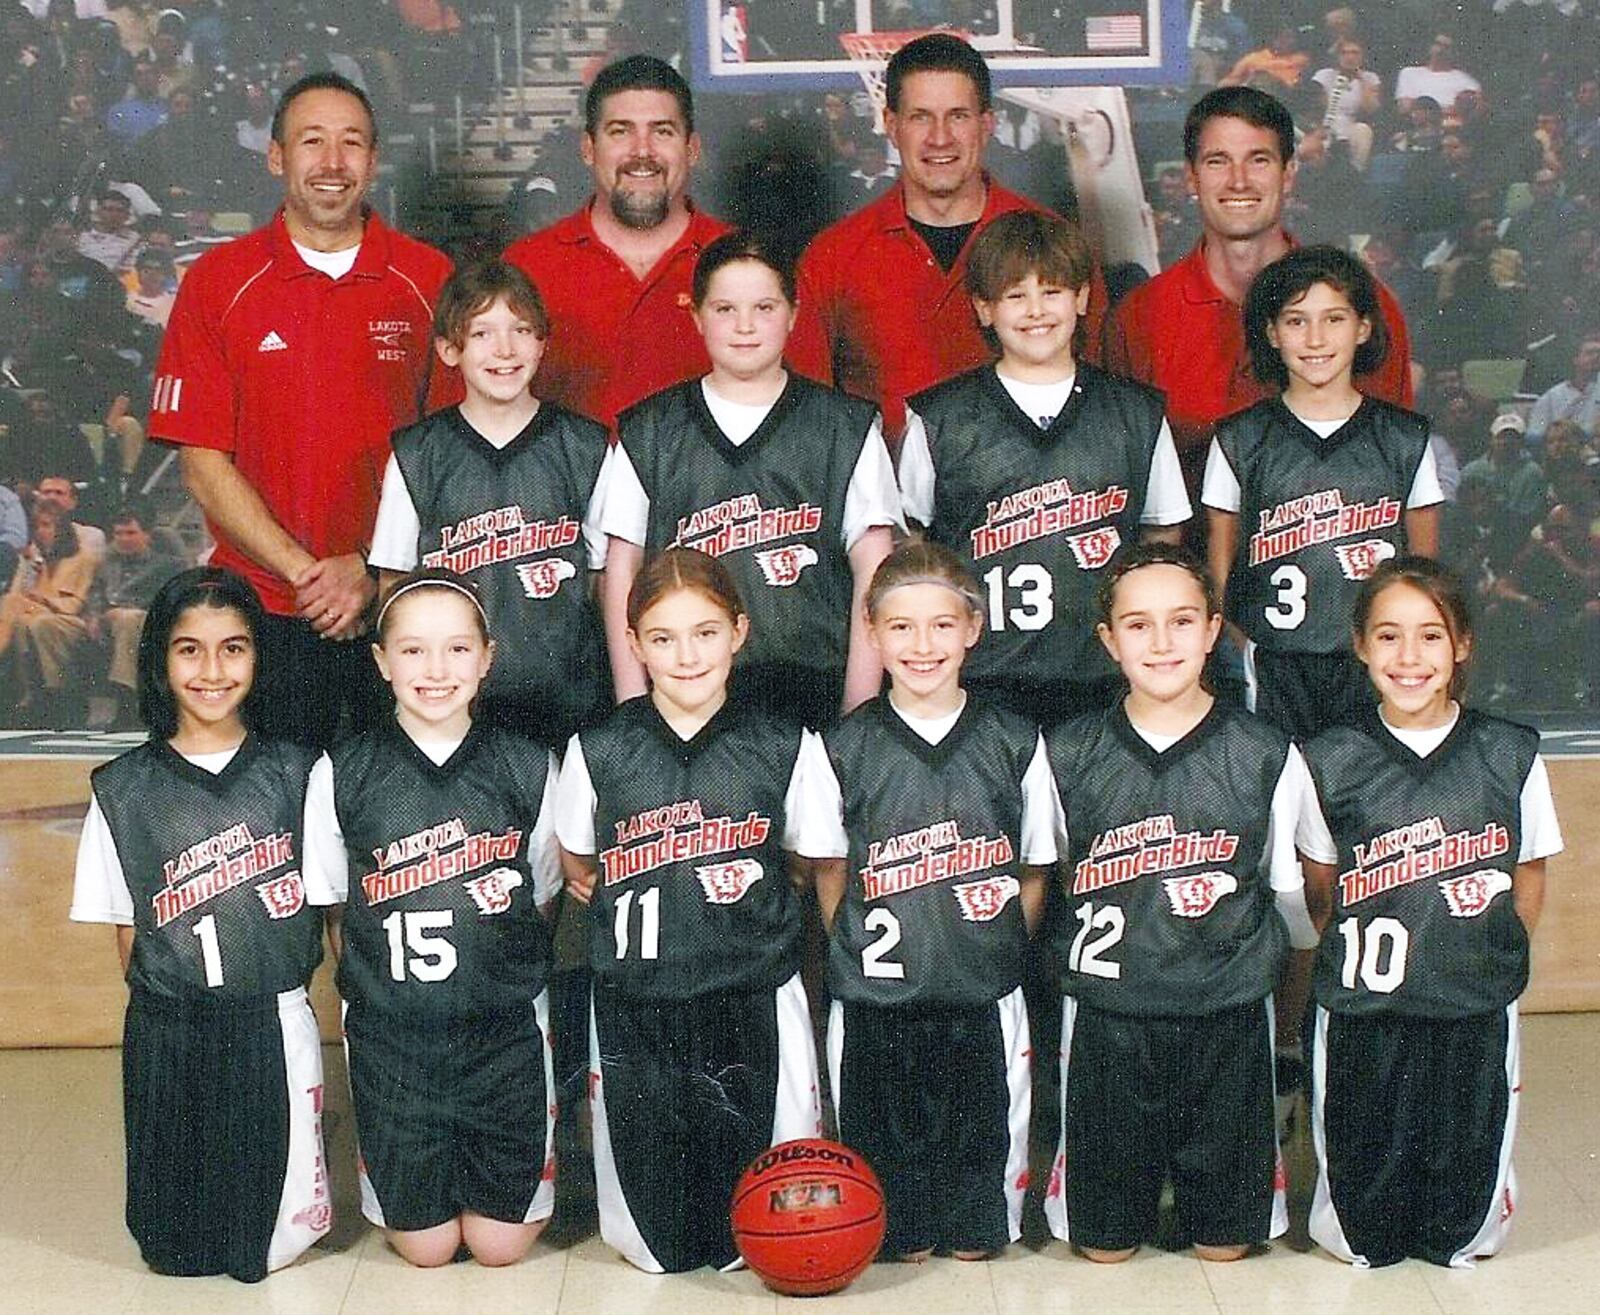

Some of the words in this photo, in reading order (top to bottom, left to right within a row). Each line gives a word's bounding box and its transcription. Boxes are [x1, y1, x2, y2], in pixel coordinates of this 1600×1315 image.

[368, 321, 412, 332] LAKOTA
[377, 350, 407, 361] WEST
[441, 505, 524, 549] LAKOTA
[677, 493, 762, 540] LAKOTA
[971, 485, 1129, 560] ThunderBirds
[986, 478, 1072, 525] LAKOTA
[1260, 489, 1344, 533] LAKOTA
[983, 564, 1054, 631] 13
[1265, 564, 1307, 630] 3
[164, 822, 254, 884] LAKOTA
[372, 818, 469, 870] LAKOTA
[600, 811, 771, 887] ThunderBirds
[615, 800, 704, 845] LAKOTA
[868, 820, 962, 867] LAKOTA
[1090, 815, 1176, 858] LAKOTA
[1353, 816, 1446, 870] LAKOTA
[1339, 822, 1509, 908] ThunderBirds
[192, 914, 225, 988] 1
[382, 909, 458, 983] 15
[614, 887, 660, 960] 11
[861, 907, 904, 979] 2
[1069, 901, 1126, 979] 12
[1338, 916, 1409, 993] 10
